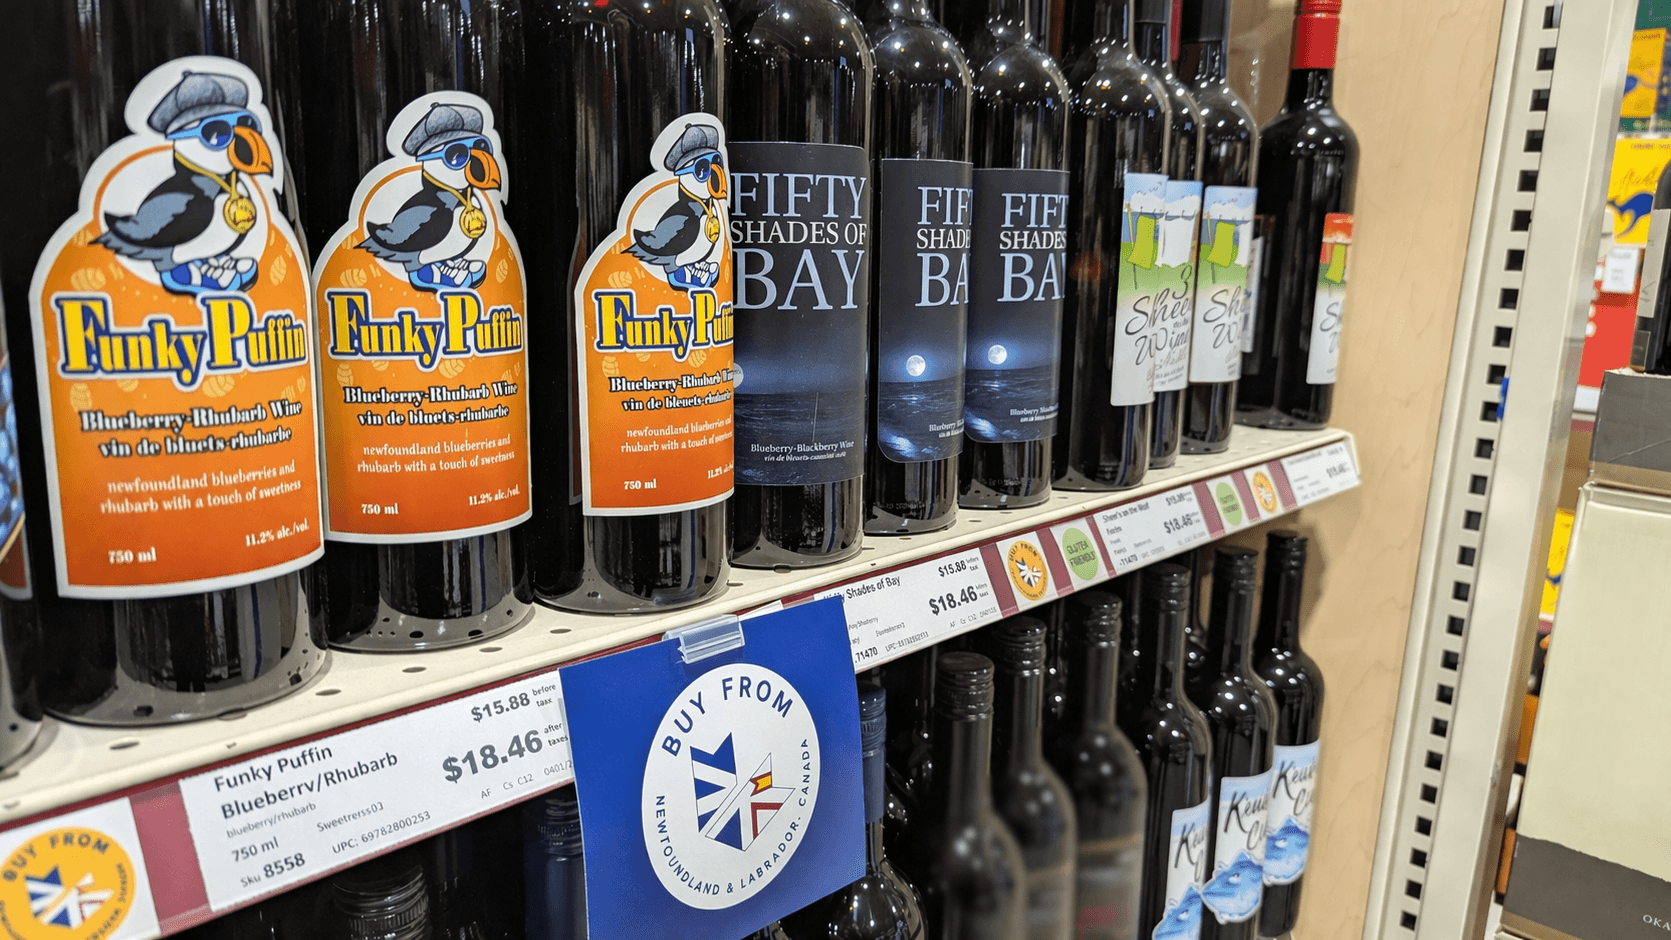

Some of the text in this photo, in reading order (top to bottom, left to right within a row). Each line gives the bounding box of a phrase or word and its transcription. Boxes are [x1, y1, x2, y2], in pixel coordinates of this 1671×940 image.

[730, 173, 866, 219] FIFTY
[731, 221, 867, 245] SHADES OF
[732, 248, 865, 310] BAY
[327, 291, 522, 369] Funky Puffin
[594, 291, 693, 359] Funky
[55, 296, 307, 387] Funky Puffin
[343, 381, 518, 408] Blueberry-Rhubarb Wine
[609, 371, 721, 393] Blueberry-Rhubarb
[79, 399, 302, 435] Blueberry-Rhubarb Wine
[622, 399, 644, 411] vin
[647, 397, 663, 410] de
[358, 411, 383, 426] vin
[386, 410, 405, 425] de
[626, 423, 689, 438] newfoundland
[98, 438, 132, 458] vin
[136, 437, 161, 457] de
[363, 433, 511, 456] newfoundland blueberries and
[621, 440, 659, 453] rhubarb
[661, 438, 679, 450] with
[681, 441, 687, 449] a
[688, 434, 707, 448] touch
[357, 459, 401, 473] rhubarb
[404, 457, 427, 472] with
[430, 461, 437, 472] a
[439, 456, 467, 471] touch
[470, 451, 479, 467] of
[107, 459, 296, 494] newfoundland blueberries and
[624, 478, 657, 490] 750 ml
[100, 479, 301, 515] rhubarb with a touch of sweetness
[361, 502, 399, 515] 750 ml
[469, 492, 493, 506] 11.2%
[245, 518, 310, 547] 11.2% alc./vol.
[108, 547, 157, 565] 750 ml
[938, 560, 967, 578] $15.88
[846, 584, 876, 599] Shades
[876, 578, 885, 590] of
[885, 576, 901, 587] Bay
[929, 586, 977, 616] $18.46
[471, 683, 557, 723] $15.88 before
[536, 697, 553, 707] tax
[661, 675, 793, 757] BUY FROM
[442, 722, 562, 784] $18.46 after
[547, 735, 569, 746] taxes
[213, 743, 333, 793] Funky Puffin
[480, 788, 492, 799] AF
[503, 781, 513, 790] Cs
[517, 773, 534, 785] C12
[226, 802, 316, 839] blueberry/rhubarb
[726, 883, 735, 894] &
[798, 738, 811, 807] CANADA
[2, 832, 110, 883] BUY FROM
[232, 836, 279, 863] 750 ml
[241, 810, 431, 888] Sku 8558 UPC: 69782800253
[1642, 914, 1671, 931] OKA
